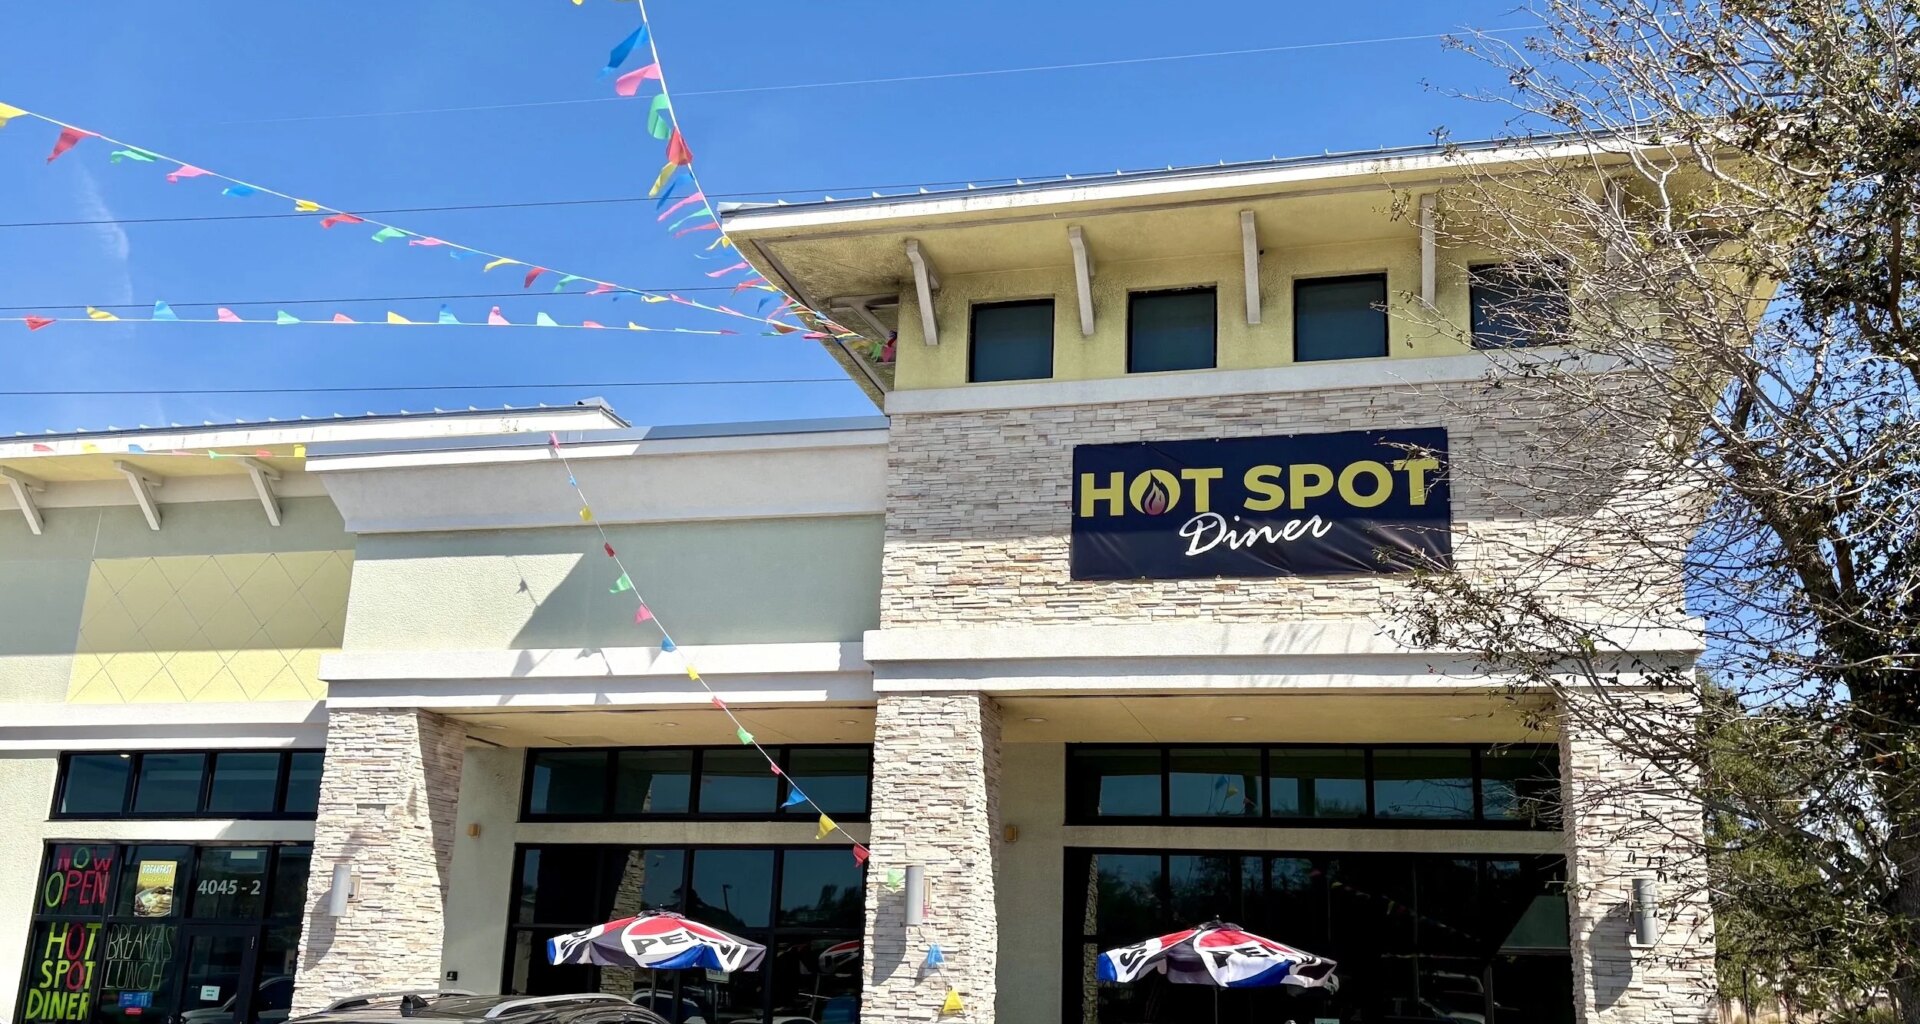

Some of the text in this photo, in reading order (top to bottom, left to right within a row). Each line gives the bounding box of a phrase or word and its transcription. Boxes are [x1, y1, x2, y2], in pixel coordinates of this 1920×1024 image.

[1080, 459, 1440, 518] HOT SPOT
[1179, 511, 1333, 556] Diner
[56, 846, 113, 871] NOW
[45, 870, 110, 908] OPEN
[197, 879, 238, 895] 4045
[250, 879, 261, 895] 2
[44, 922, 103, 960] HOT
[106, 924, 178, 960] BREAKFAS
[39, 959, 96, 990] SPOT
[104, 956, 166, 989] LUNCH
[25, 988, 92, 1021] DINER
